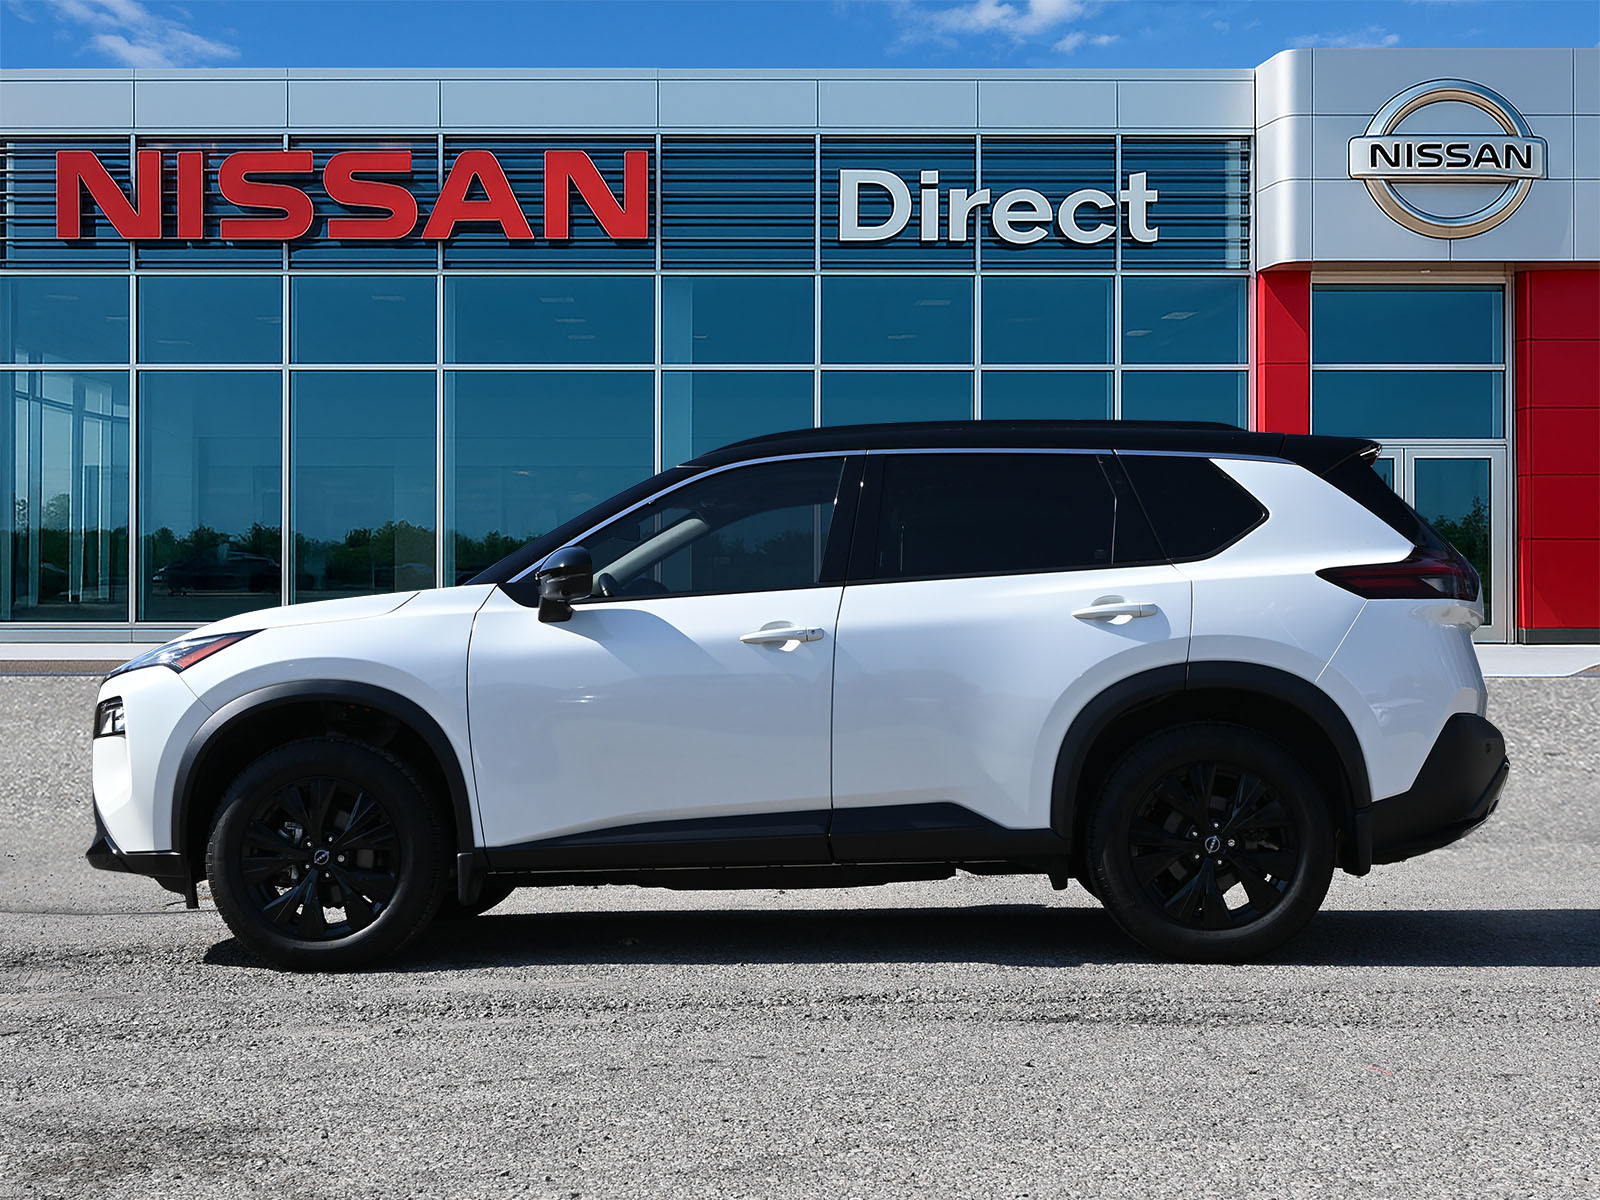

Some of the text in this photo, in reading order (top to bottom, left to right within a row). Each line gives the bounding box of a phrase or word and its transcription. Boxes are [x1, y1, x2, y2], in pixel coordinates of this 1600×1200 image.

[1370, 143, 1532, 169] NISSAN
[56, 150, 1159, 244] NISSAN Direct
